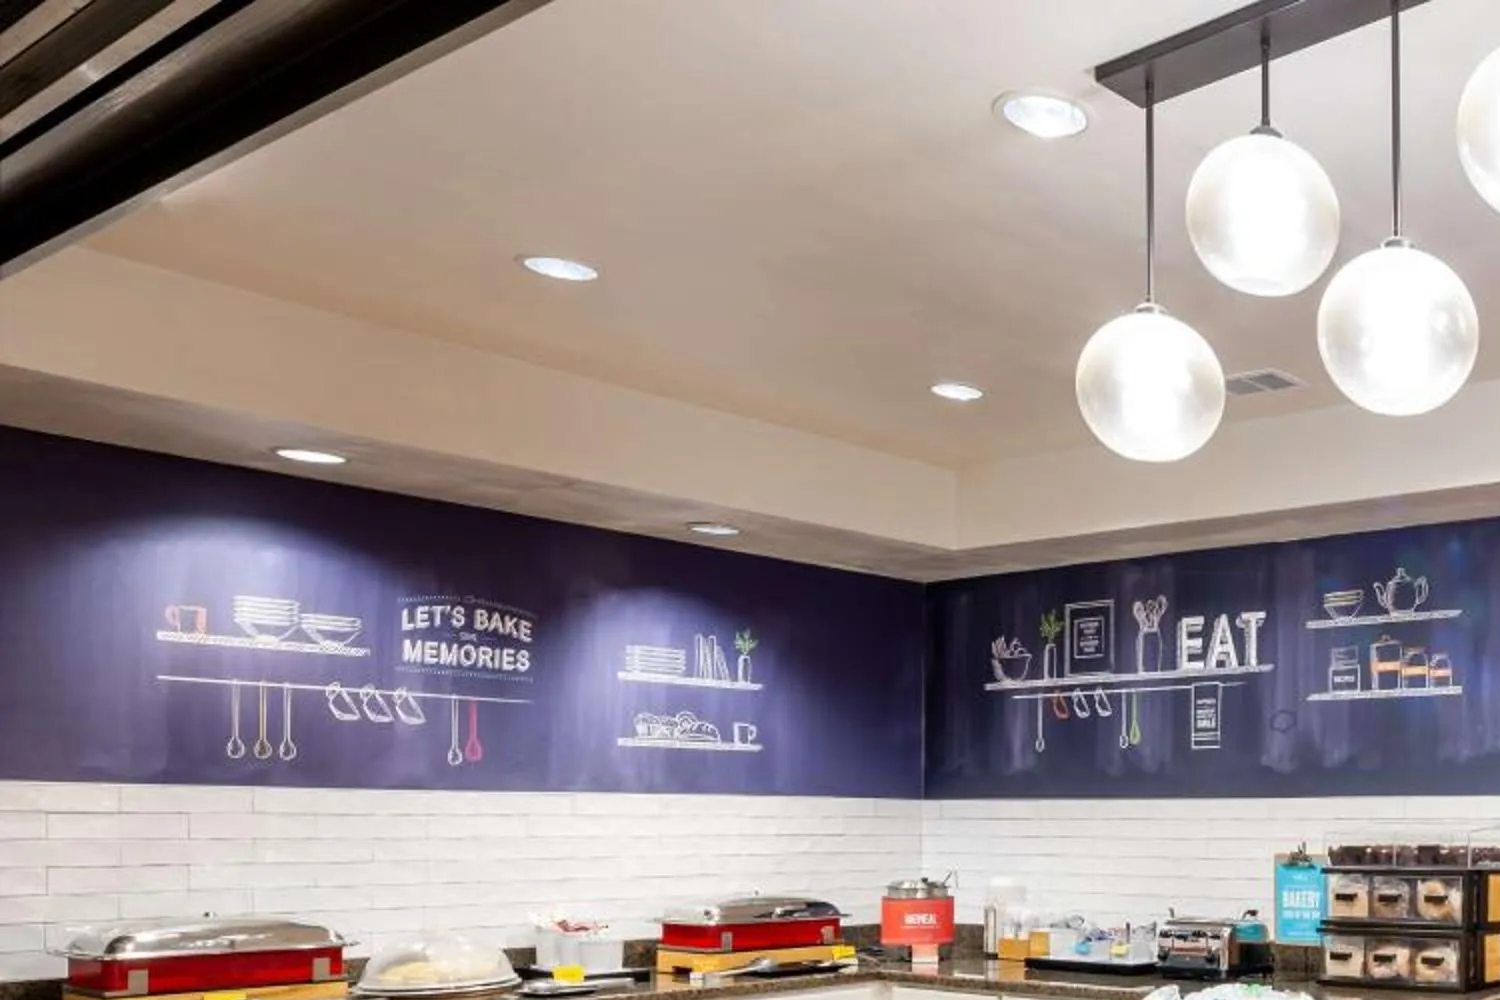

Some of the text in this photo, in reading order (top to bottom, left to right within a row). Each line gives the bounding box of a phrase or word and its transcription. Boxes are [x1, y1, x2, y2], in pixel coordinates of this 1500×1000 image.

[401, 604, 534, 643] LET'S BAKE
[1177, 610, 1267, 672] EAT
[402, 638, 531, 673] MEMORIES
